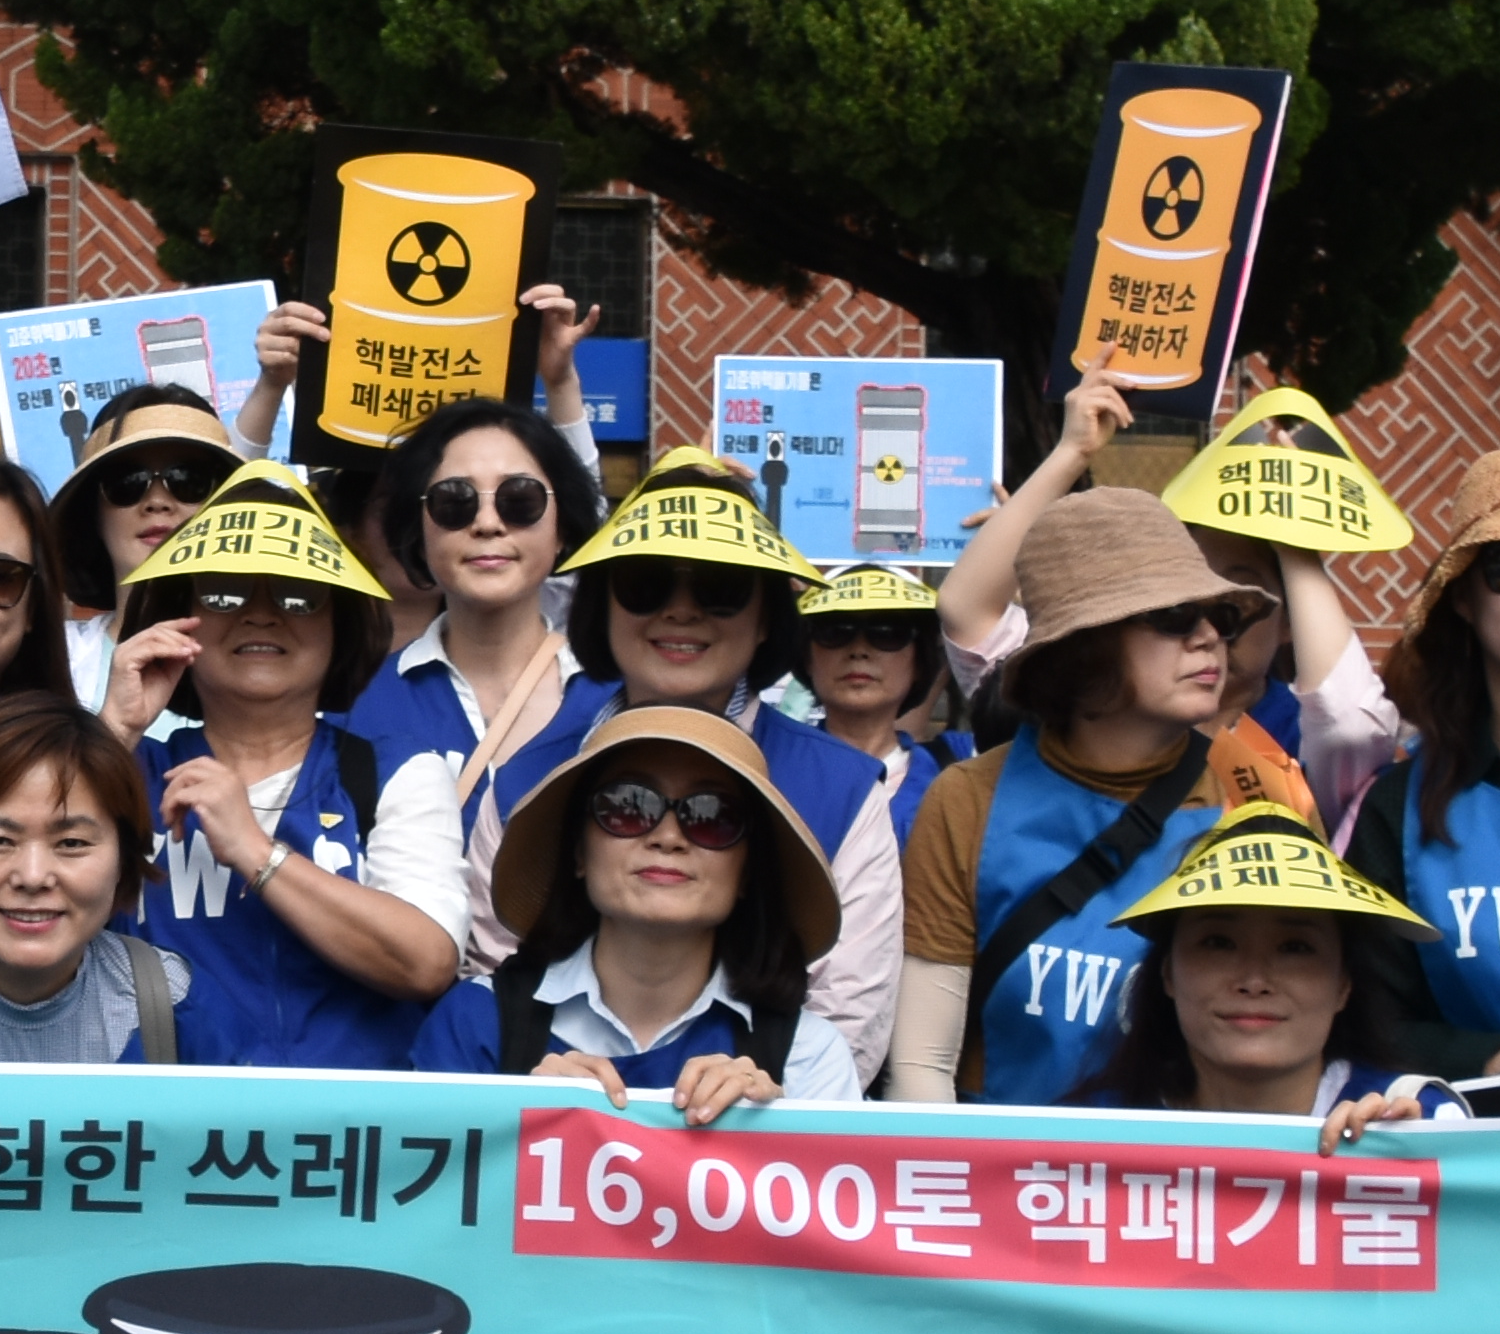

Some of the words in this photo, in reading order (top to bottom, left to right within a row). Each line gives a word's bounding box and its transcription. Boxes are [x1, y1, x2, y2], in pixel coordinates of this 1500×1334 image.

[1108, 273, 1196, 316] 핵발전소
[354, 337, 482, 380] 핵발전소
[1096, 318, 1189, 359] 폐쇄하자
[1217, 458, 1369, 509] 핵폐기물
[1217, 490, 1372, 540] 이제그만
[168, 534, 346, 577] 이제그만
[611, 518, 790, 564] 이제그만
[1176, 866, 1388, 909] 이제그만
[183, 1126, 482, 1227] 쓰레기
[522, 1135, 981, 1259] 16,000톤
[1013, 1158, 1432, 1267] 핵폐기물
